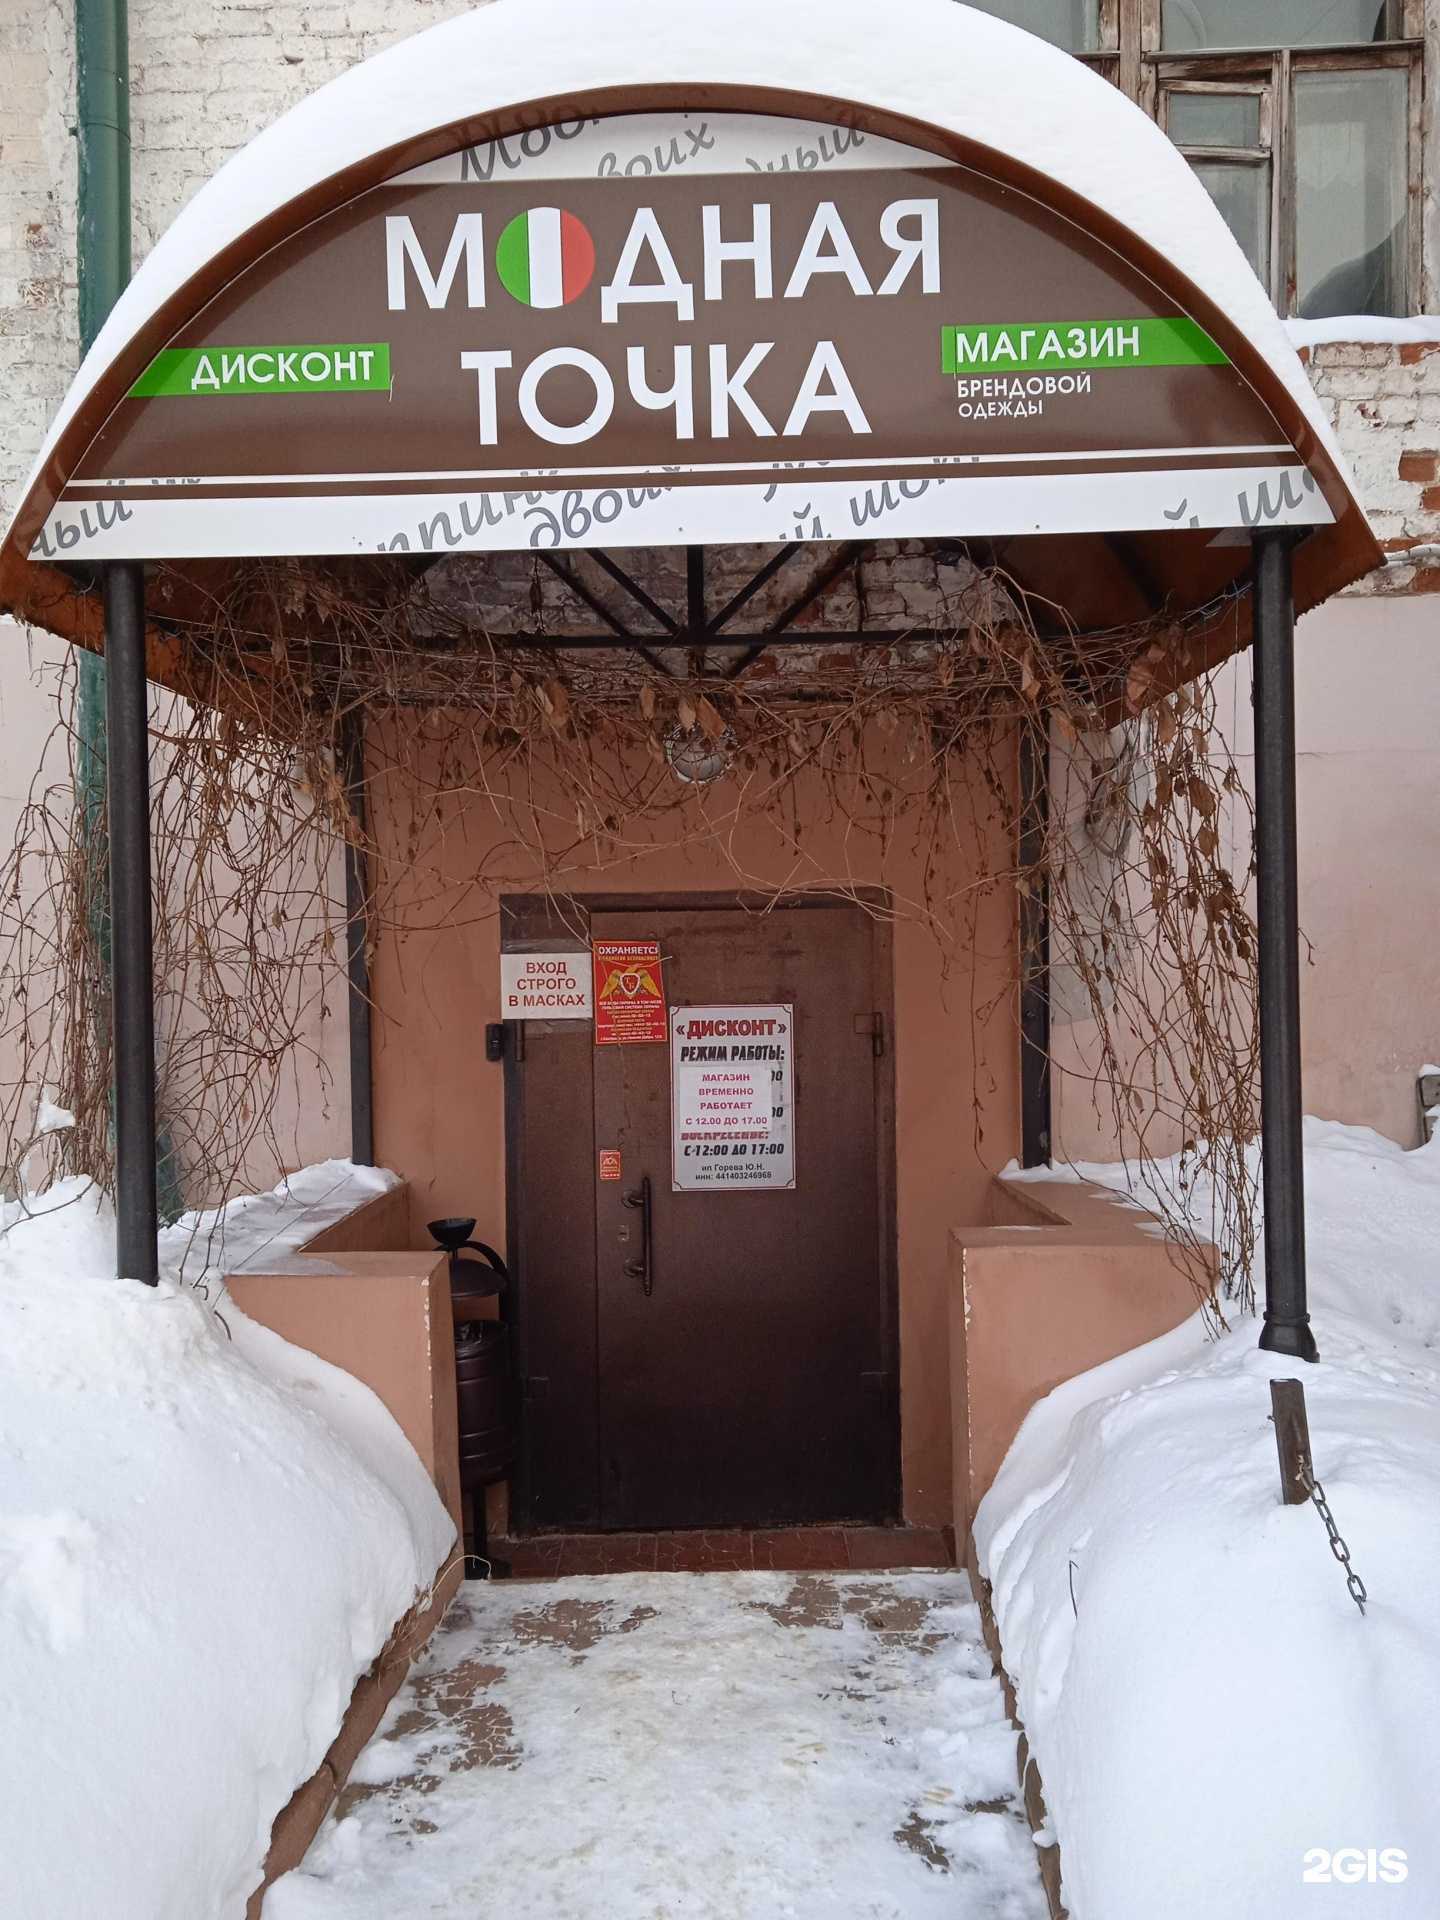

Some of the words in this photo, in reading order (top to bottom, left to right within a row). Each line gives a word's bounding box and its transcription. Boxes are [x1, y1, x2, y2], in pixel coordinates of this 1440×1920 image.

[385, 198, 942, 323] МОДНАЯ
[956, 326, 1140, 363] МАГАЗИН
[191, 351, 374, 390] ДИСКОНТ
[957, 372, 1092, 398] БРЕНДОВОЙ
[460, 341, 872, 446] ТОЧКА
[958, 400, 1043, 420] ОДЕЖДЫ
[526, 962, 567, 975] ВХОД
[517, 978, 576, 990] СТРОГО
[508, 995, 518, 1007] В
[523, 994, 585, 1007] МАСКАХ
[676, 1019, 787, 1040] «ДИСКОНТ»
[680, 1045, 727, 1062] РЕЖИМ
[731, 1044, 785, 1061] РАБОТЫ:
[702, 1073, 750, 1082] МАГАЗИН
[698, 1087, 754, 1096] ВРЕМЕННО
[700, 1101, 753, 1110] РАБОТАЕТ
[695, 1117, 721, 1125] 12.00
[723, 1117, 739, 1126] ДО
[742, 1116, 768, 1125] 17.00
[731, 1144, 747, 1156] ДО
[751, 1143, 785, 1156] 17:00
